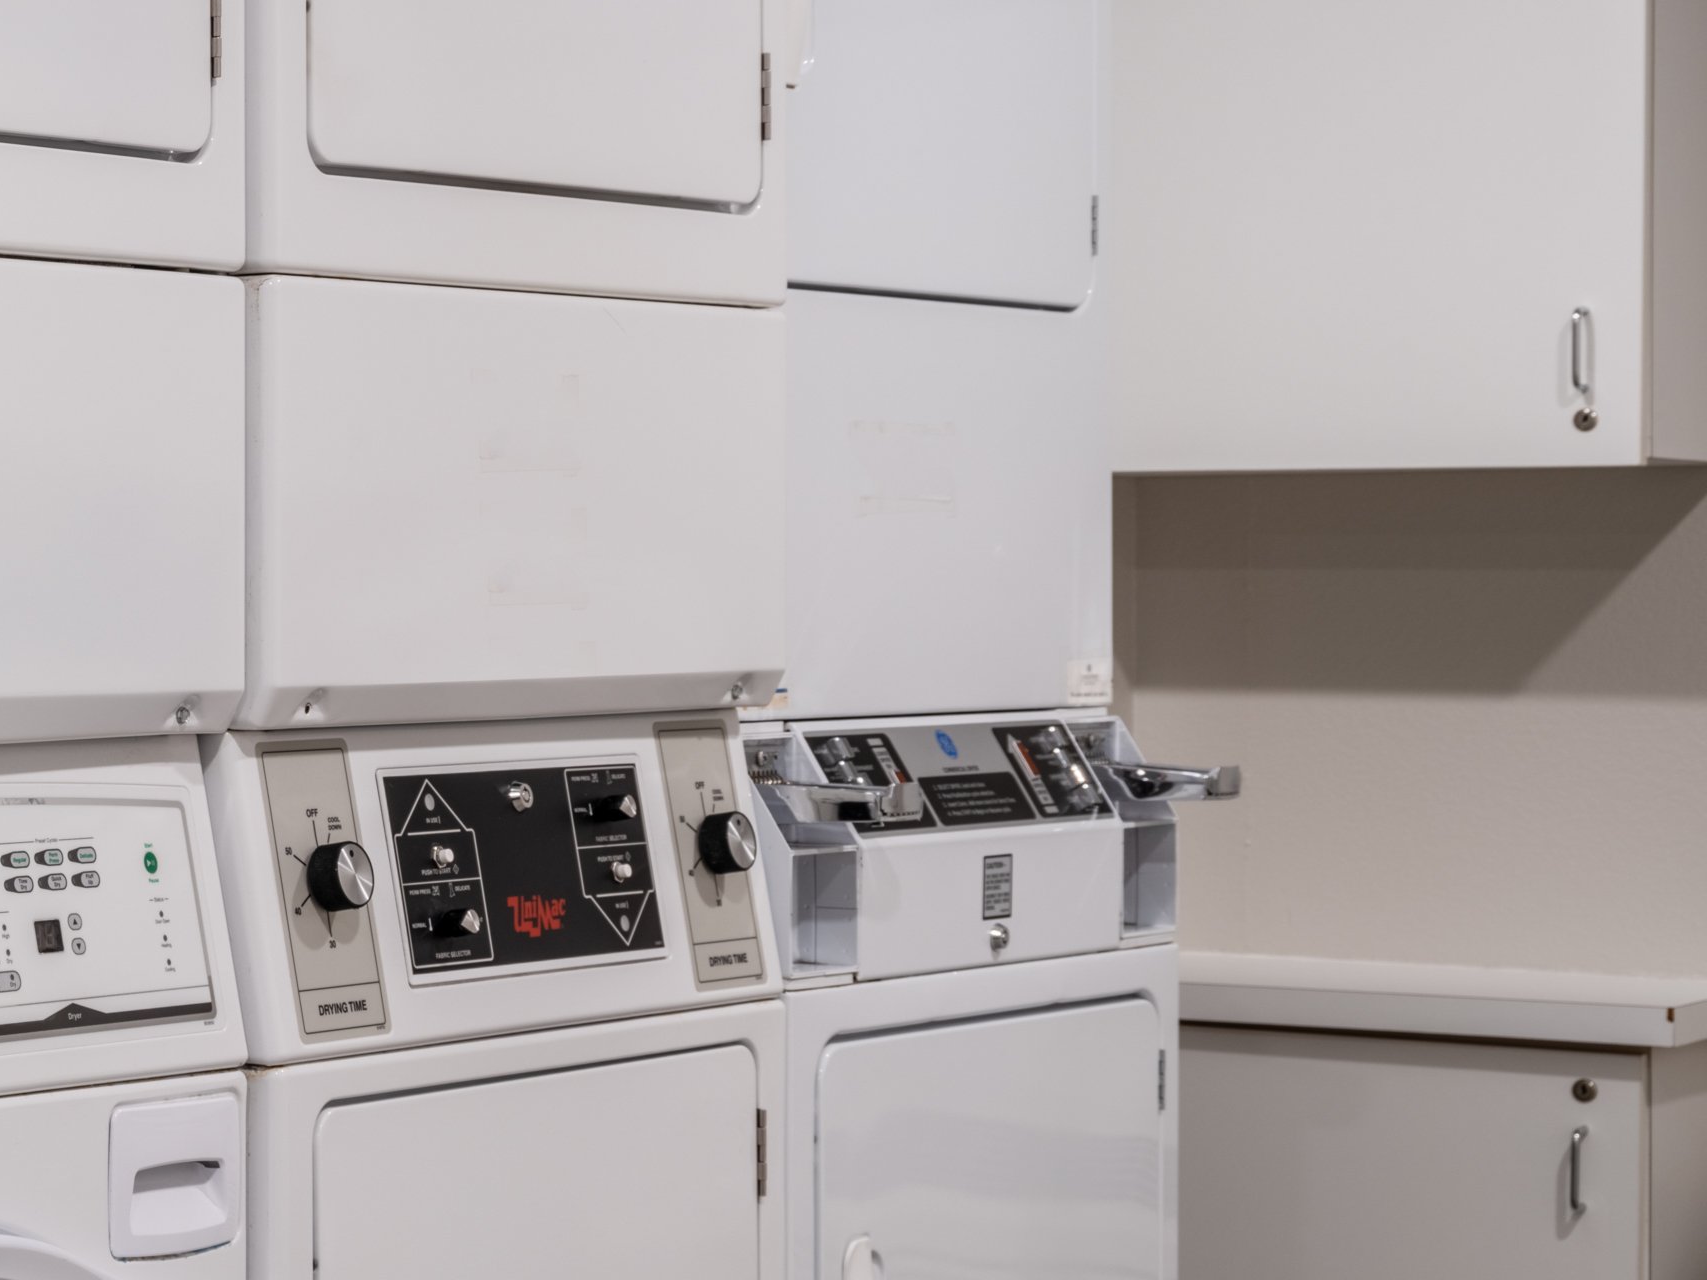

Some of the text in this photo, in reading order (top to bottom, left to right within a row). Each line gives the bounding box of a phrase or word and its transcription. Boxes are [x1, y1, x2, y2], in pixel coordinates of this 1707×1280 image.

[306, 809, 318, 817] OFF
[709, 953, 747, 967] DRYING TIME
[319, 1000, 367, 1016] DRYING TIME
[68, 1012, 81, 1020] Dryer
